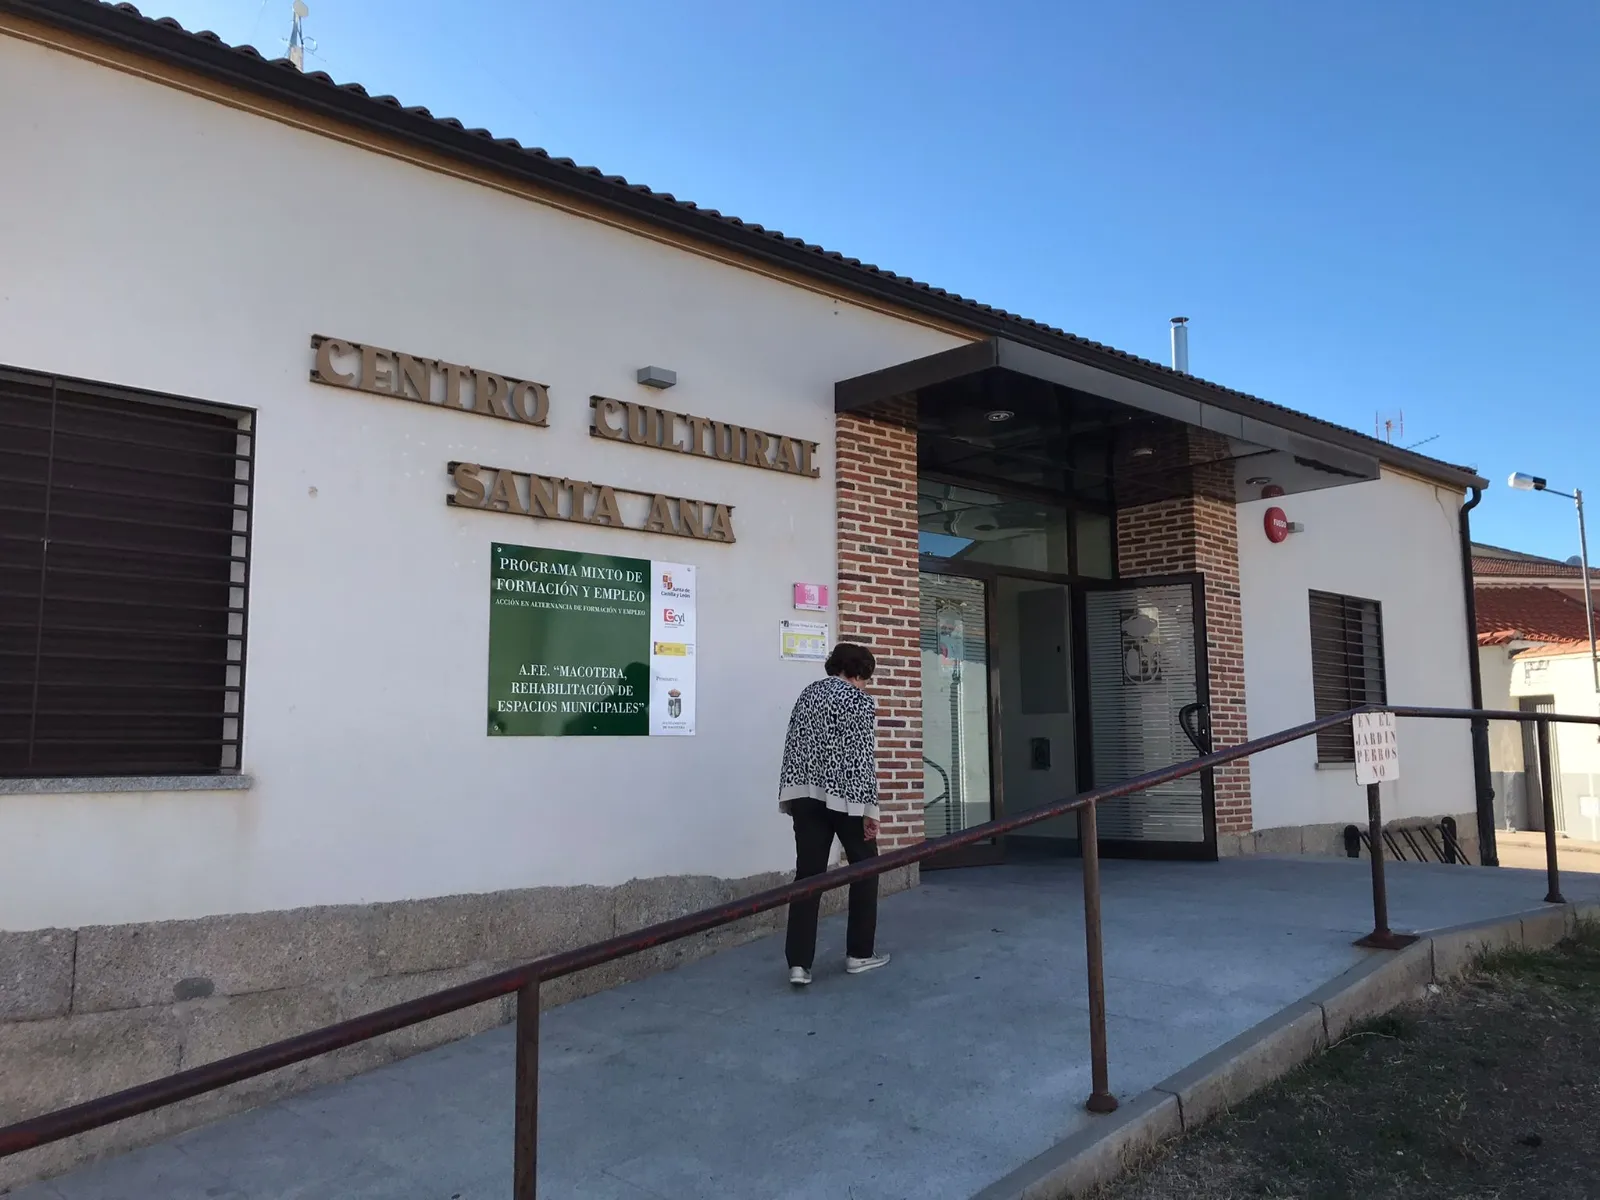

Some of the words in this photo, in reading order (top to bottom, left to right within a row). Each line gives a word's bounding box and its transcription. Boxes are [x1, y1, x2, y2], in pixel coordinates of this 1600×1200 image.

[316, 338, 550, 425] CENTRO
[594, 396, 820, 478] CULTURAL
[452, 461, 624, 528] SANTA
[644, 493, 736, 543] ANA
[1273, 518, 1287, 529] FUEGO
[499, 557, 578, 577] PROGRAMA
[581, 565, 623, 581] MIXTO
[626, 570, 643, 583] DE
[496, 578, 578, 597] FORMACIÓN
[581, 585, 591, 598] Y
[594, 587, 645, 603] EMPLEO
[495, 598, 520, 607] ACCIÓN
[530, 600, 573, 610] ALTERNANCIA
[583, 605, 617, 614] FORMACIÓN
[519, 664, 550, 676] A.F.E.
[553, 665, 628, 680] “MACOTERA,
[511, 682, 615, 696] REHABILITACIÓN
[618, 685, 634, 696] DE
[497, 700, 558, 713] ESPACIOS
[560, 701, 645, 714] MUNICIPALES”
[1357, 714, 1371, 728] EN
[1378, 713, 1391, 727] EL
[1355, 730, 1397, 746] JARDIN
[1356, 747, 1398, 763] PERROS
[1372, 764, 1386, 778] NO
